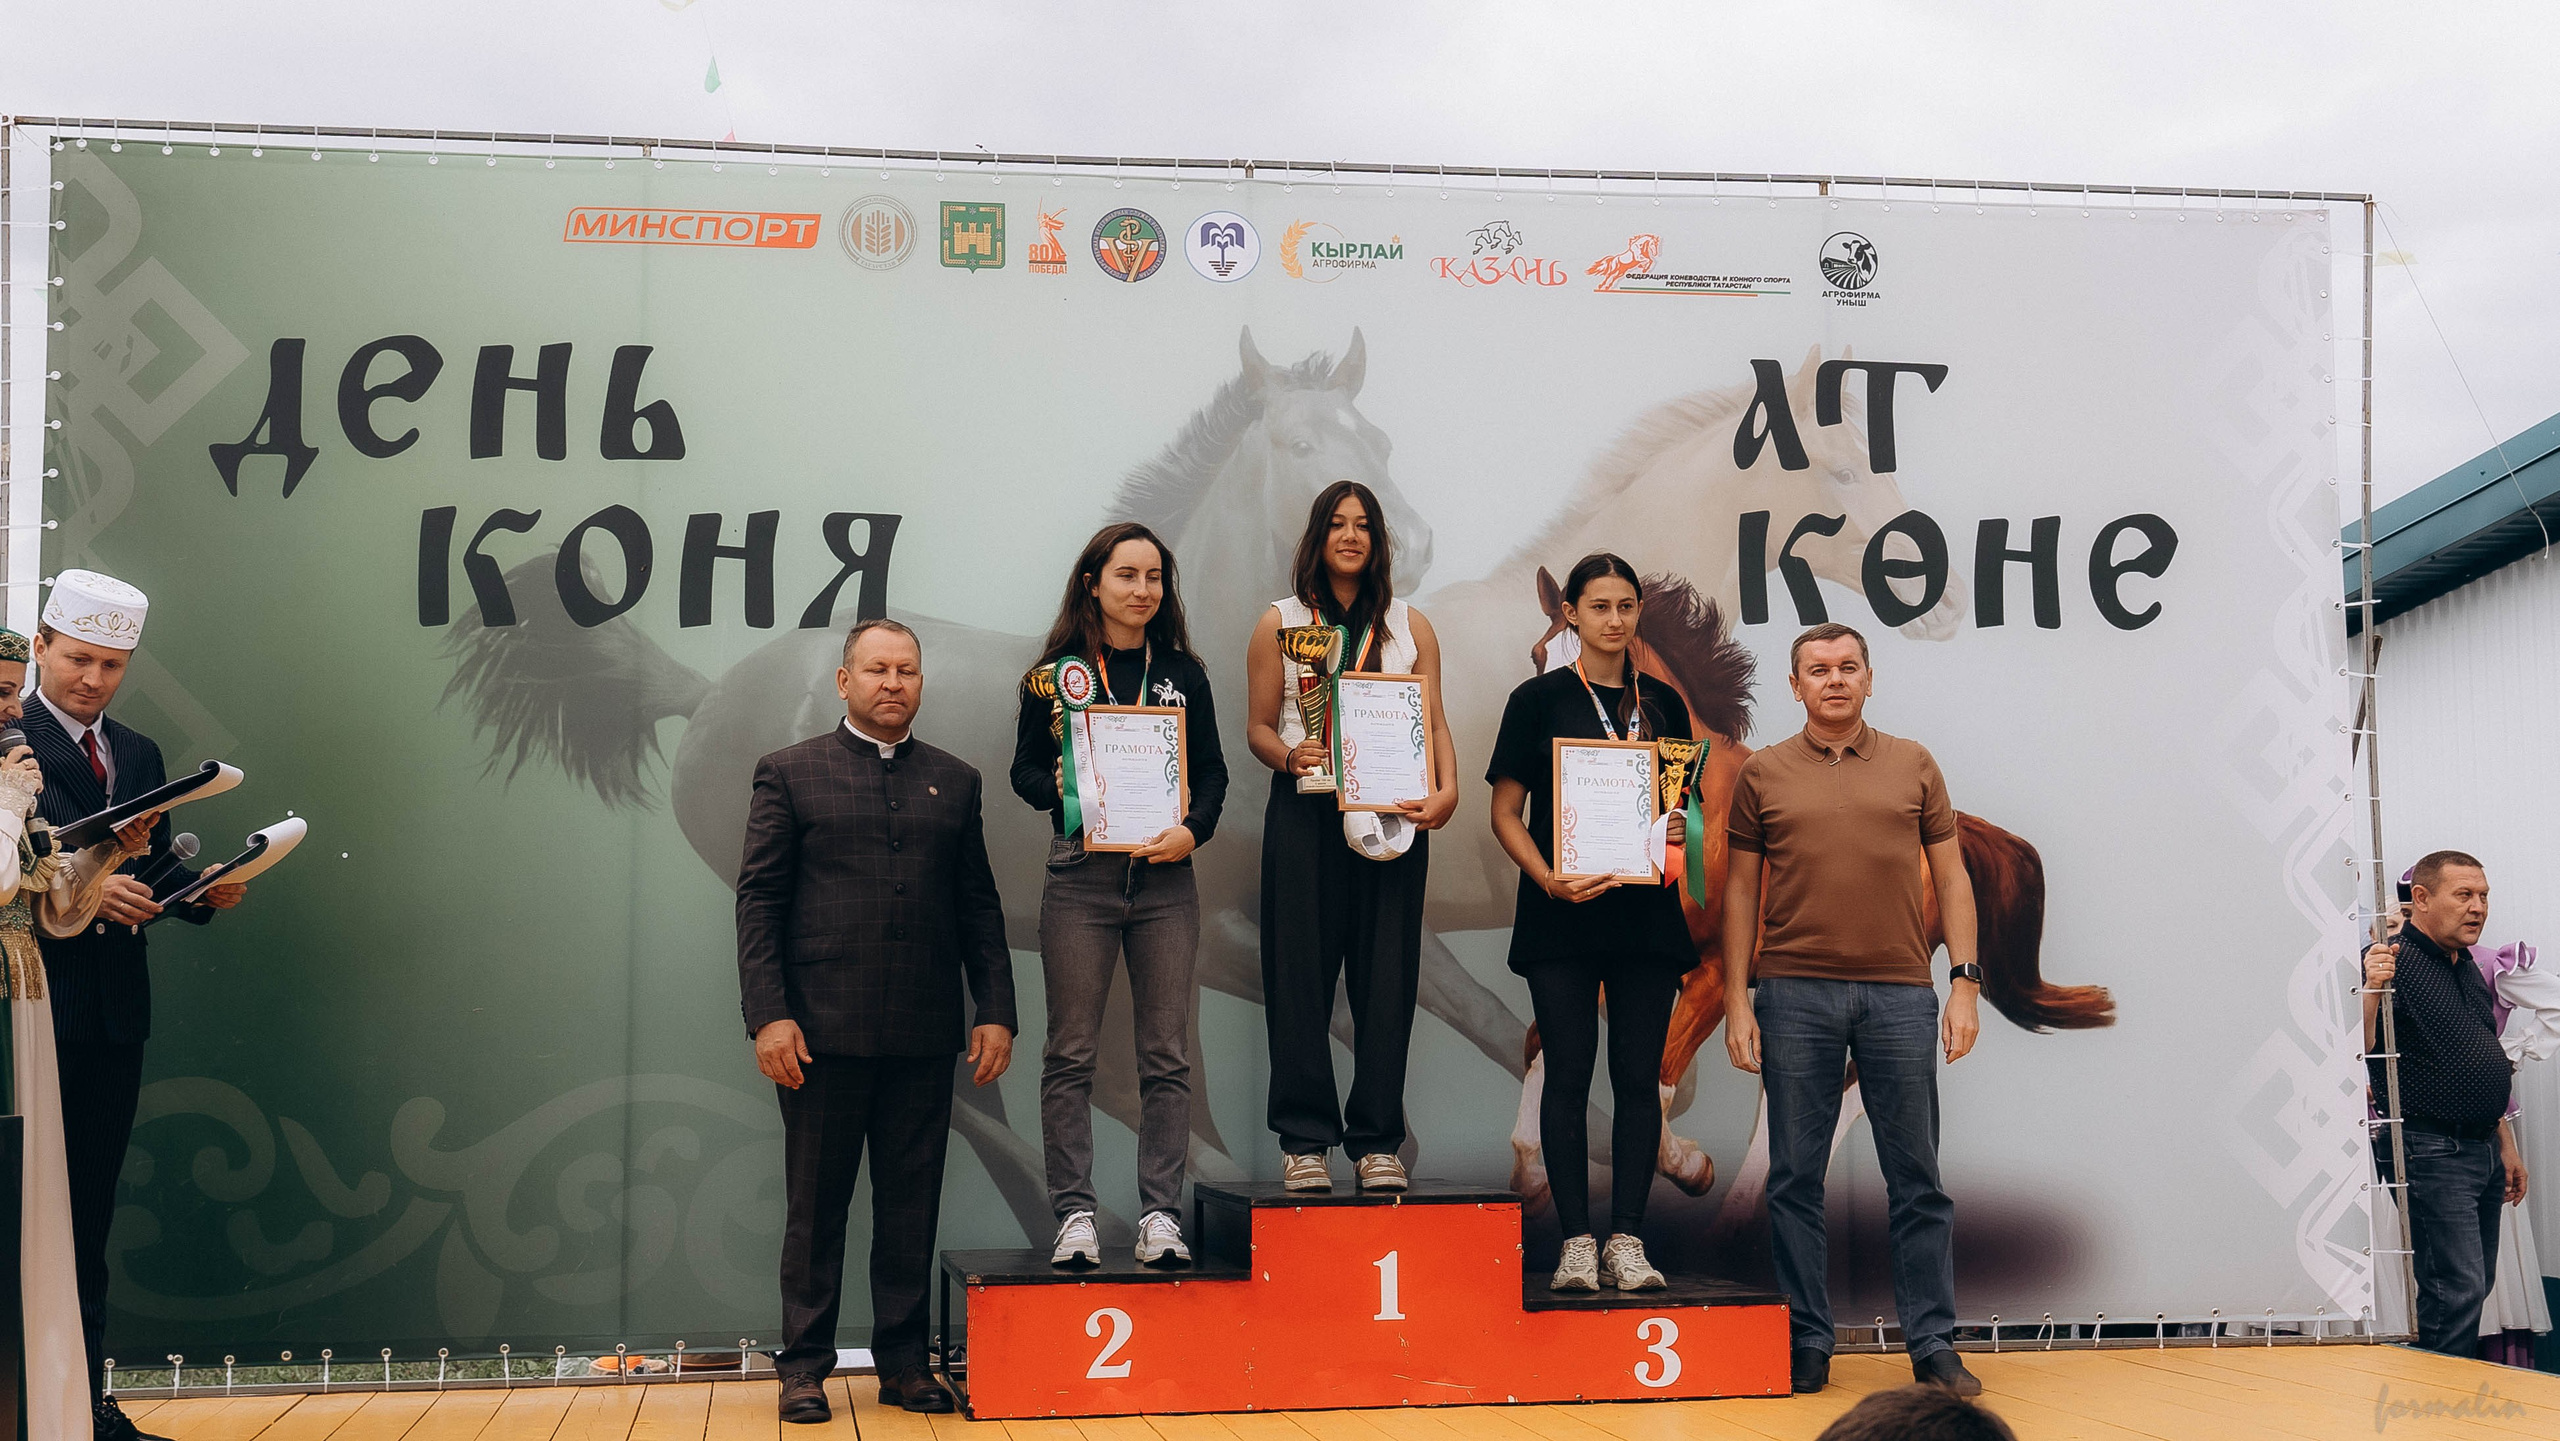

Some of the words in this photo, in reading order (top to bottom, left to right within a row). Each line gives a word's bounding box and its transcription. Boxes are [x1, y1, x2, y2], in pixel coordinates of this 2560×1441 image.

[573, 213, 818, 243] МИНСПОРТ
[1028, 243, 1050, 261] 80
[1311, 234, 1403, 260] КЫРЛАЙ
[1028, 264, 1068, 275] ПОБЕДА!
[1312, 259, 1377, 269] АГРОФИРМА
[1430, 256, 1568, 287] КАЗАНЬ
[1625, 273, 1669, 281] ФЕДЕРАЦИЯ
[1670, 274, 1721, 282] КОНЕВОДСТВА
[1822, 291, 1881, 299] АГРОФИРМА
[1836, 299, 1867, 307] УНЫШ
[208, 334, 687, 499] ДЕНЬ
[1732, 358, 1949, 475] АТ
[418, 504, 903, 629] КОНЯ
[1354, 709, 1409, 720] ГРАМОТА
[1105, 744, 1164, 755] ГРАМОТА
[1577, 776, 1636, 788] ГРАМОТА
[1372, 1250, 1406, 1321] 1
[1084, 1307, 1133, 1379] 2
[1634, 1317, 1682, 1387] 3
